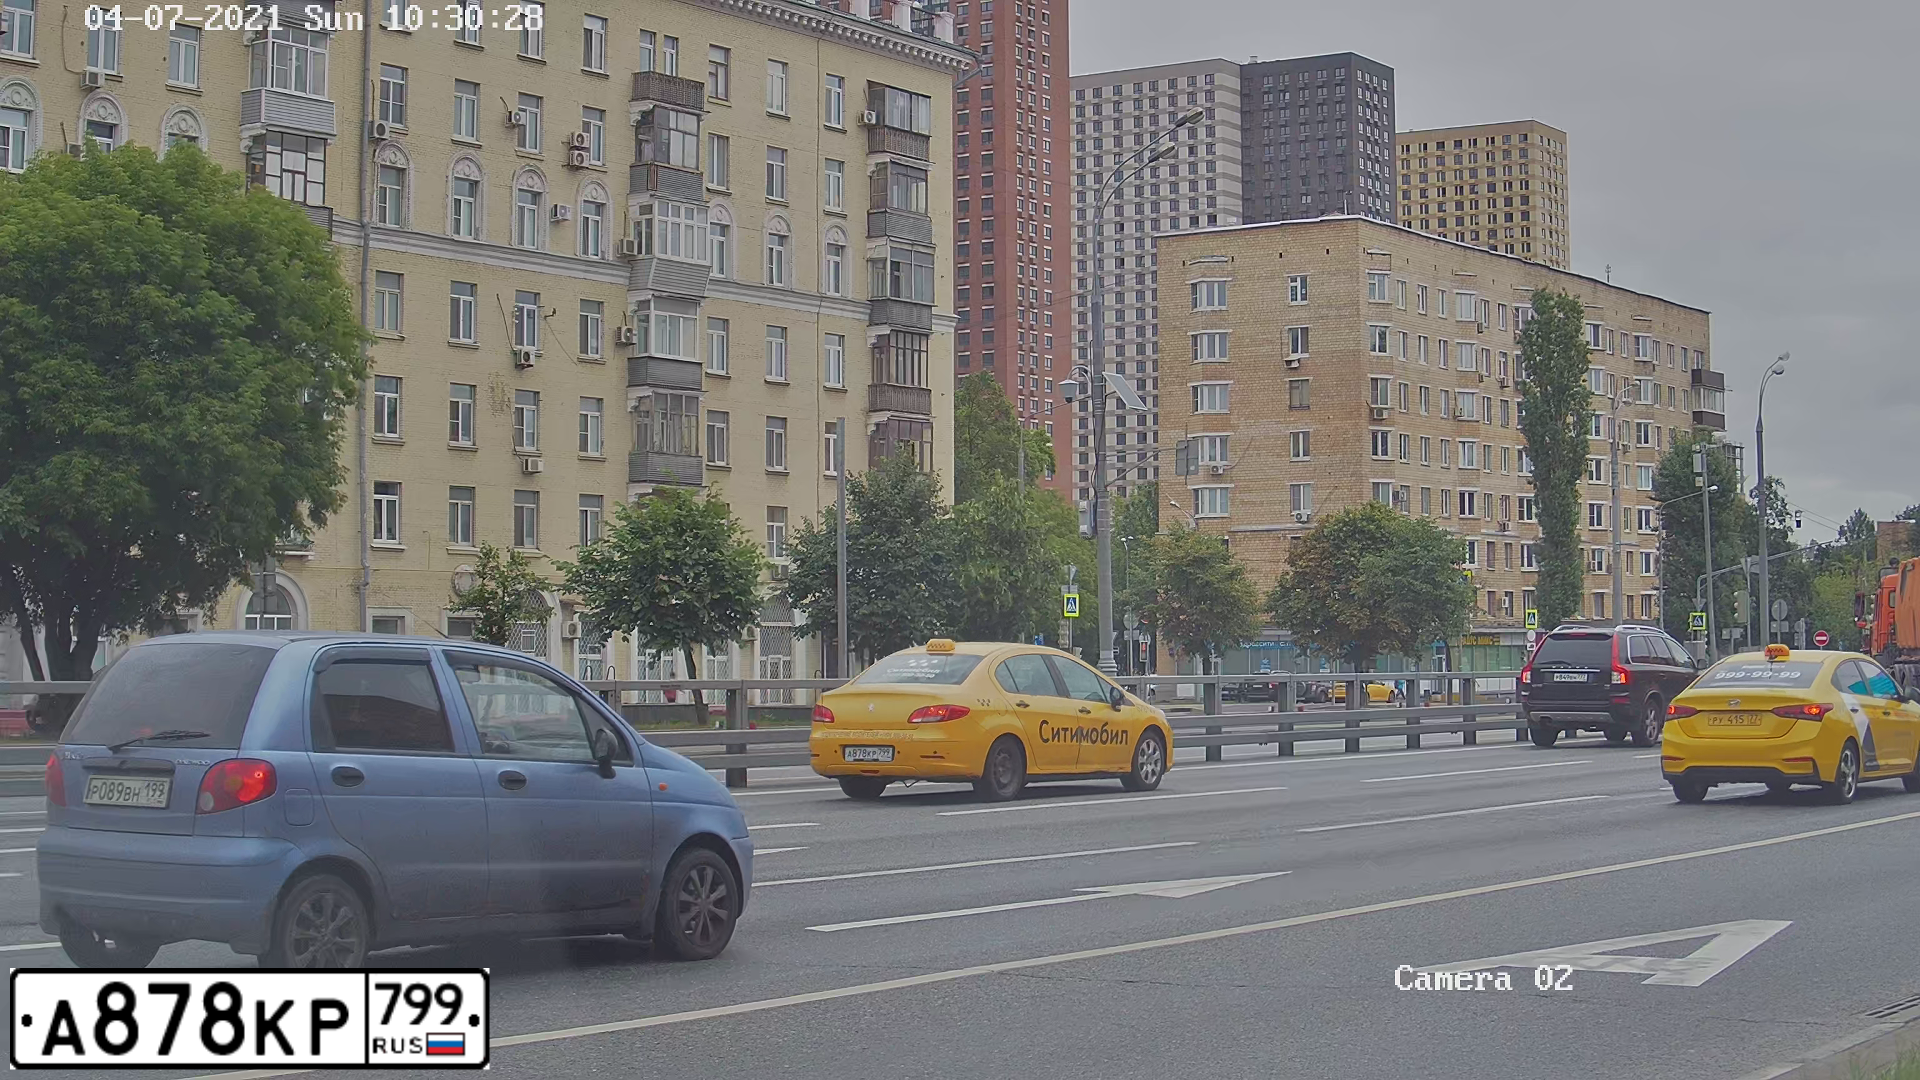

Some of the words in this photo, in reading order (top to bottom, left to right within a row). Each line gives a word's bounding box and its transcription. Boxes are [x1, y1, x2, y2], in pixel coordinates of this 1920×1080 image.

[1714, 670, 1802, 680] 999-99-99
[1038, 719, 1129, 746] Ситимобил
[846, 748, 877, 758] А878КР
[90, 781, 141, 803] Р089ВН
[144, 779, 165, 798] 199
